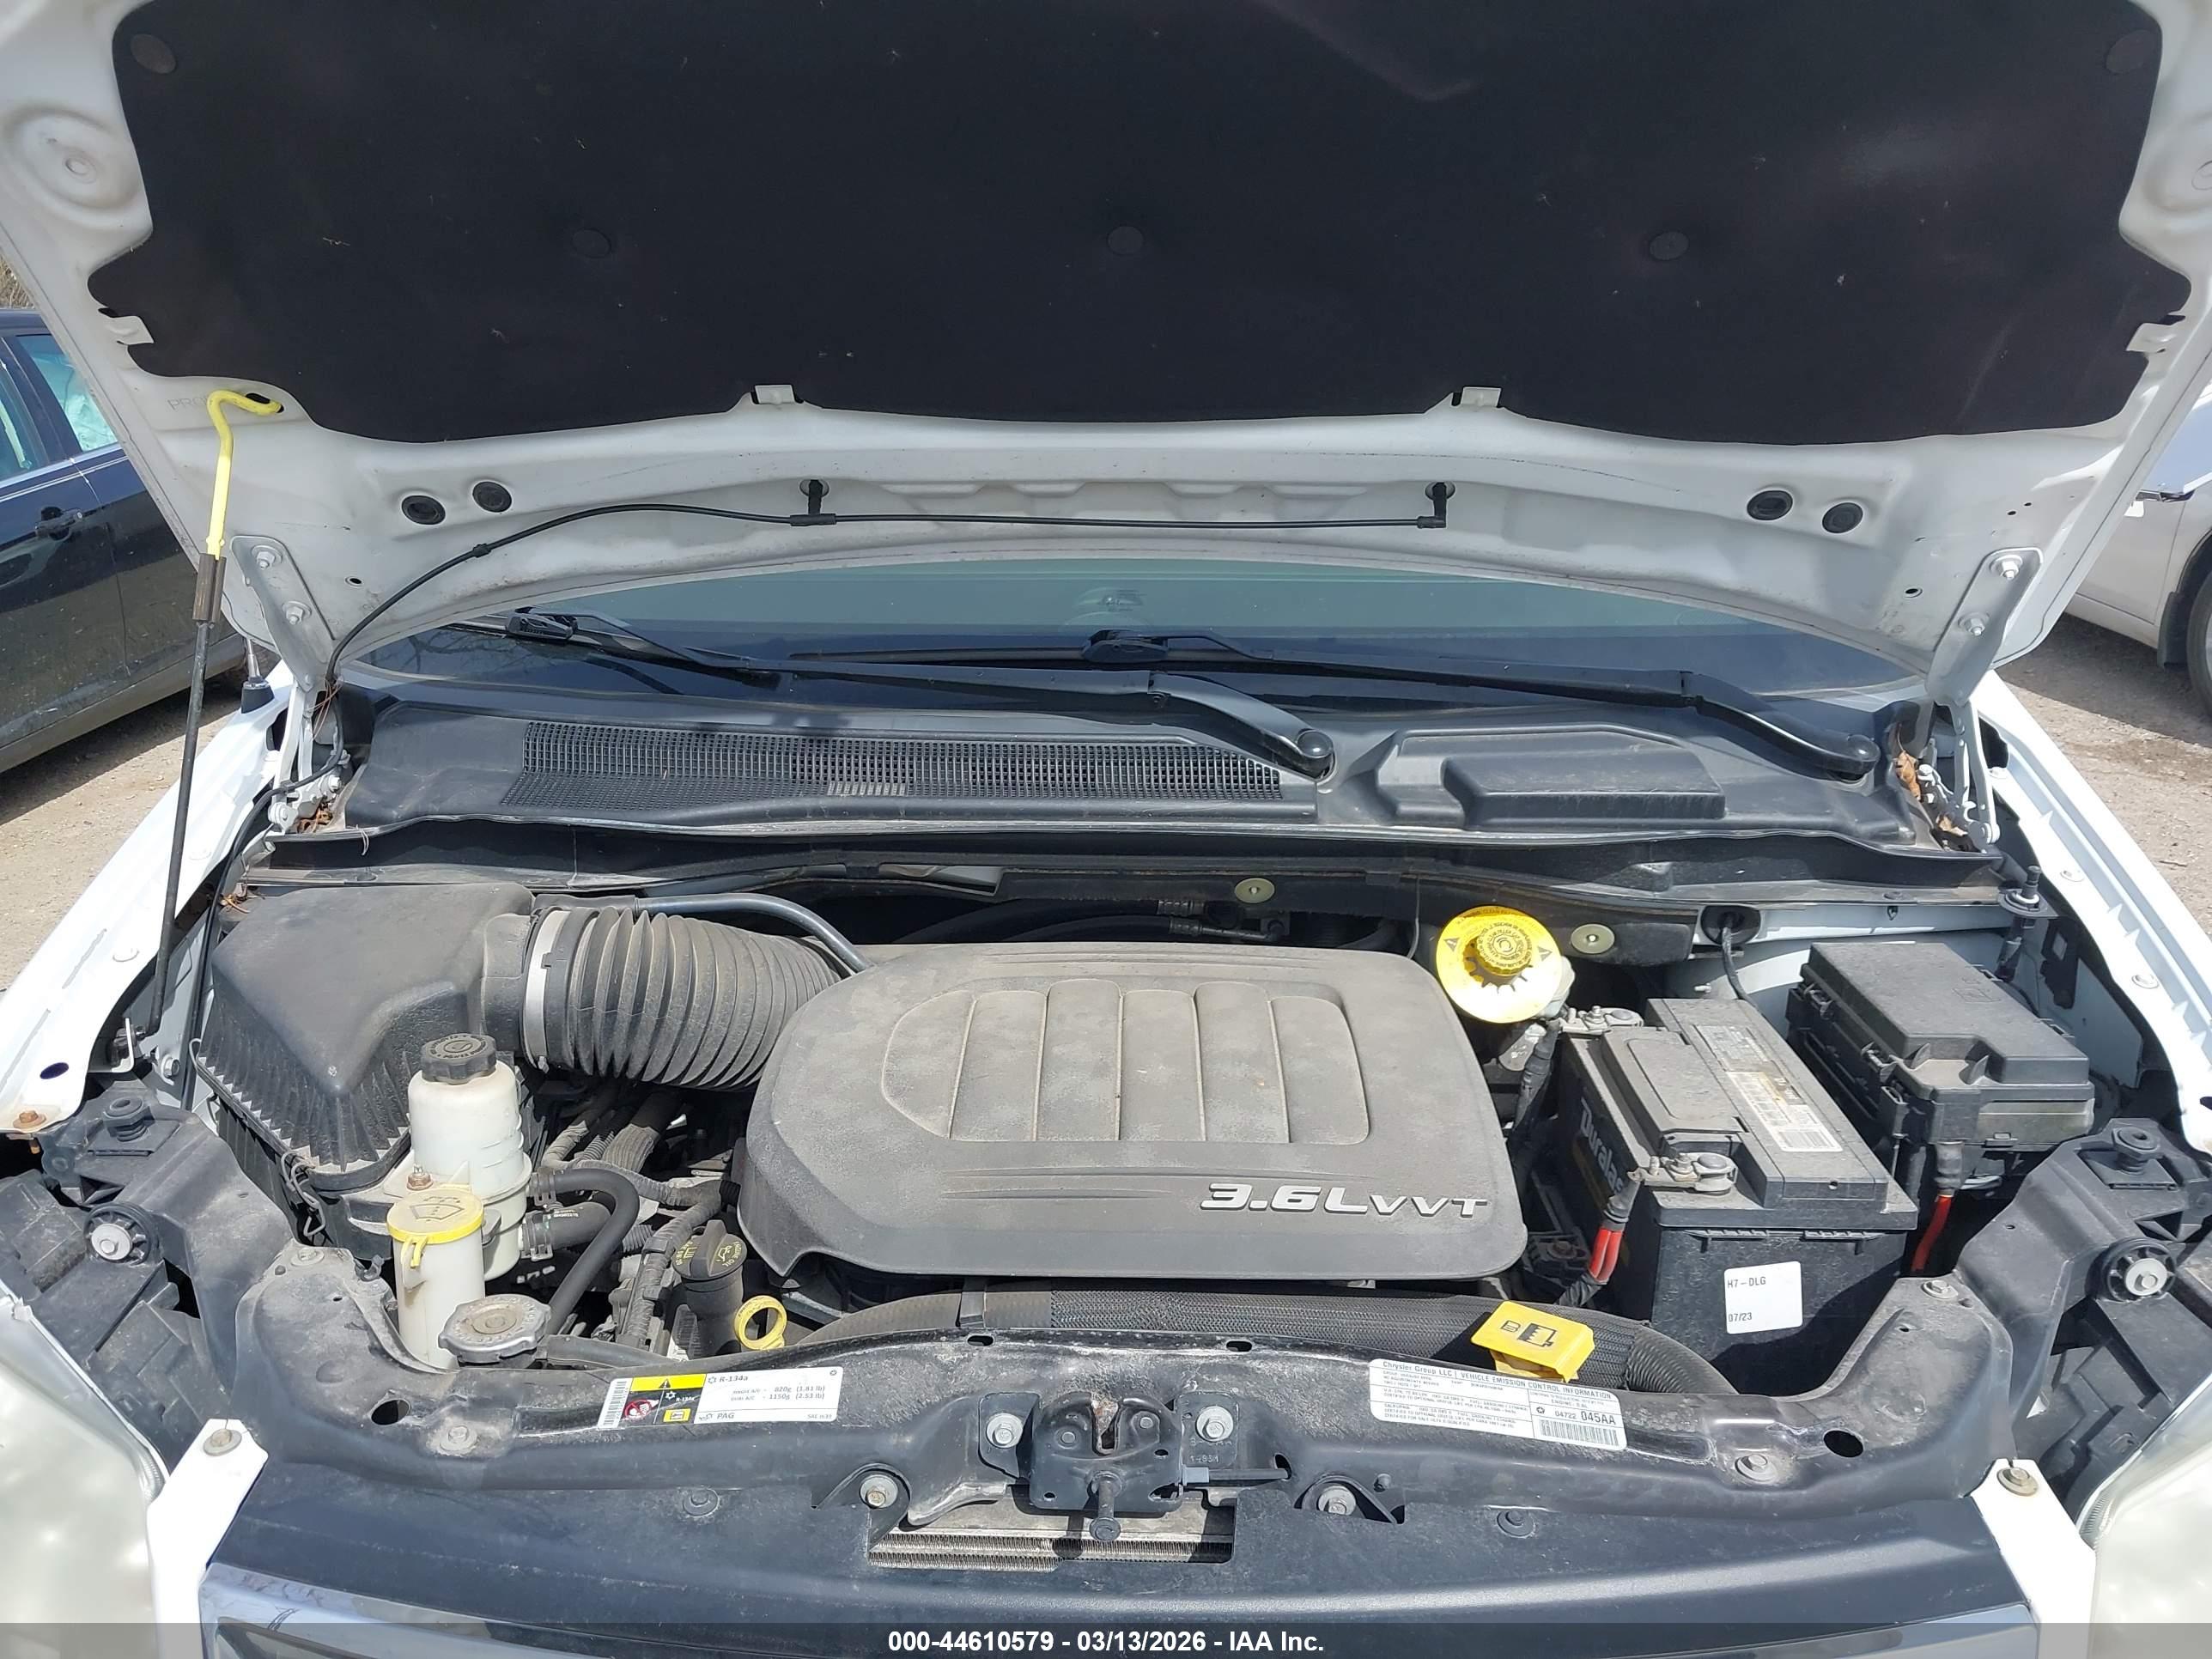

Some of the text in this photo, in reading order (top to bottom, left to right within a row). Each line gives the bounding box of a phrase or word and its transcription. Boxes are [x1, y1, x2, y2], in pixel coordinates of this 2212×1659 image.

[167, 398, 210, 410] PRO
[1580, 1097, 1624, 1194] Duralas
[721, 1258, 735, 1267] OIL
[1728, 1312, 1753, 1322] 07/23
[1382, 1361, 1413, 1370] Chrysler
[1414, 1365, 1437, 1375] Group
[1461, 1372, 1489, 1382] VEHICLE
[1492, 1376, 1526, 1387] EMISSION
[1528, 1382, 1559, 1393] CONTROL
[1563, 1387, 1611, 1399] INFORMATION
[1554, 1411, 1617, 1425] 04722 045AA
